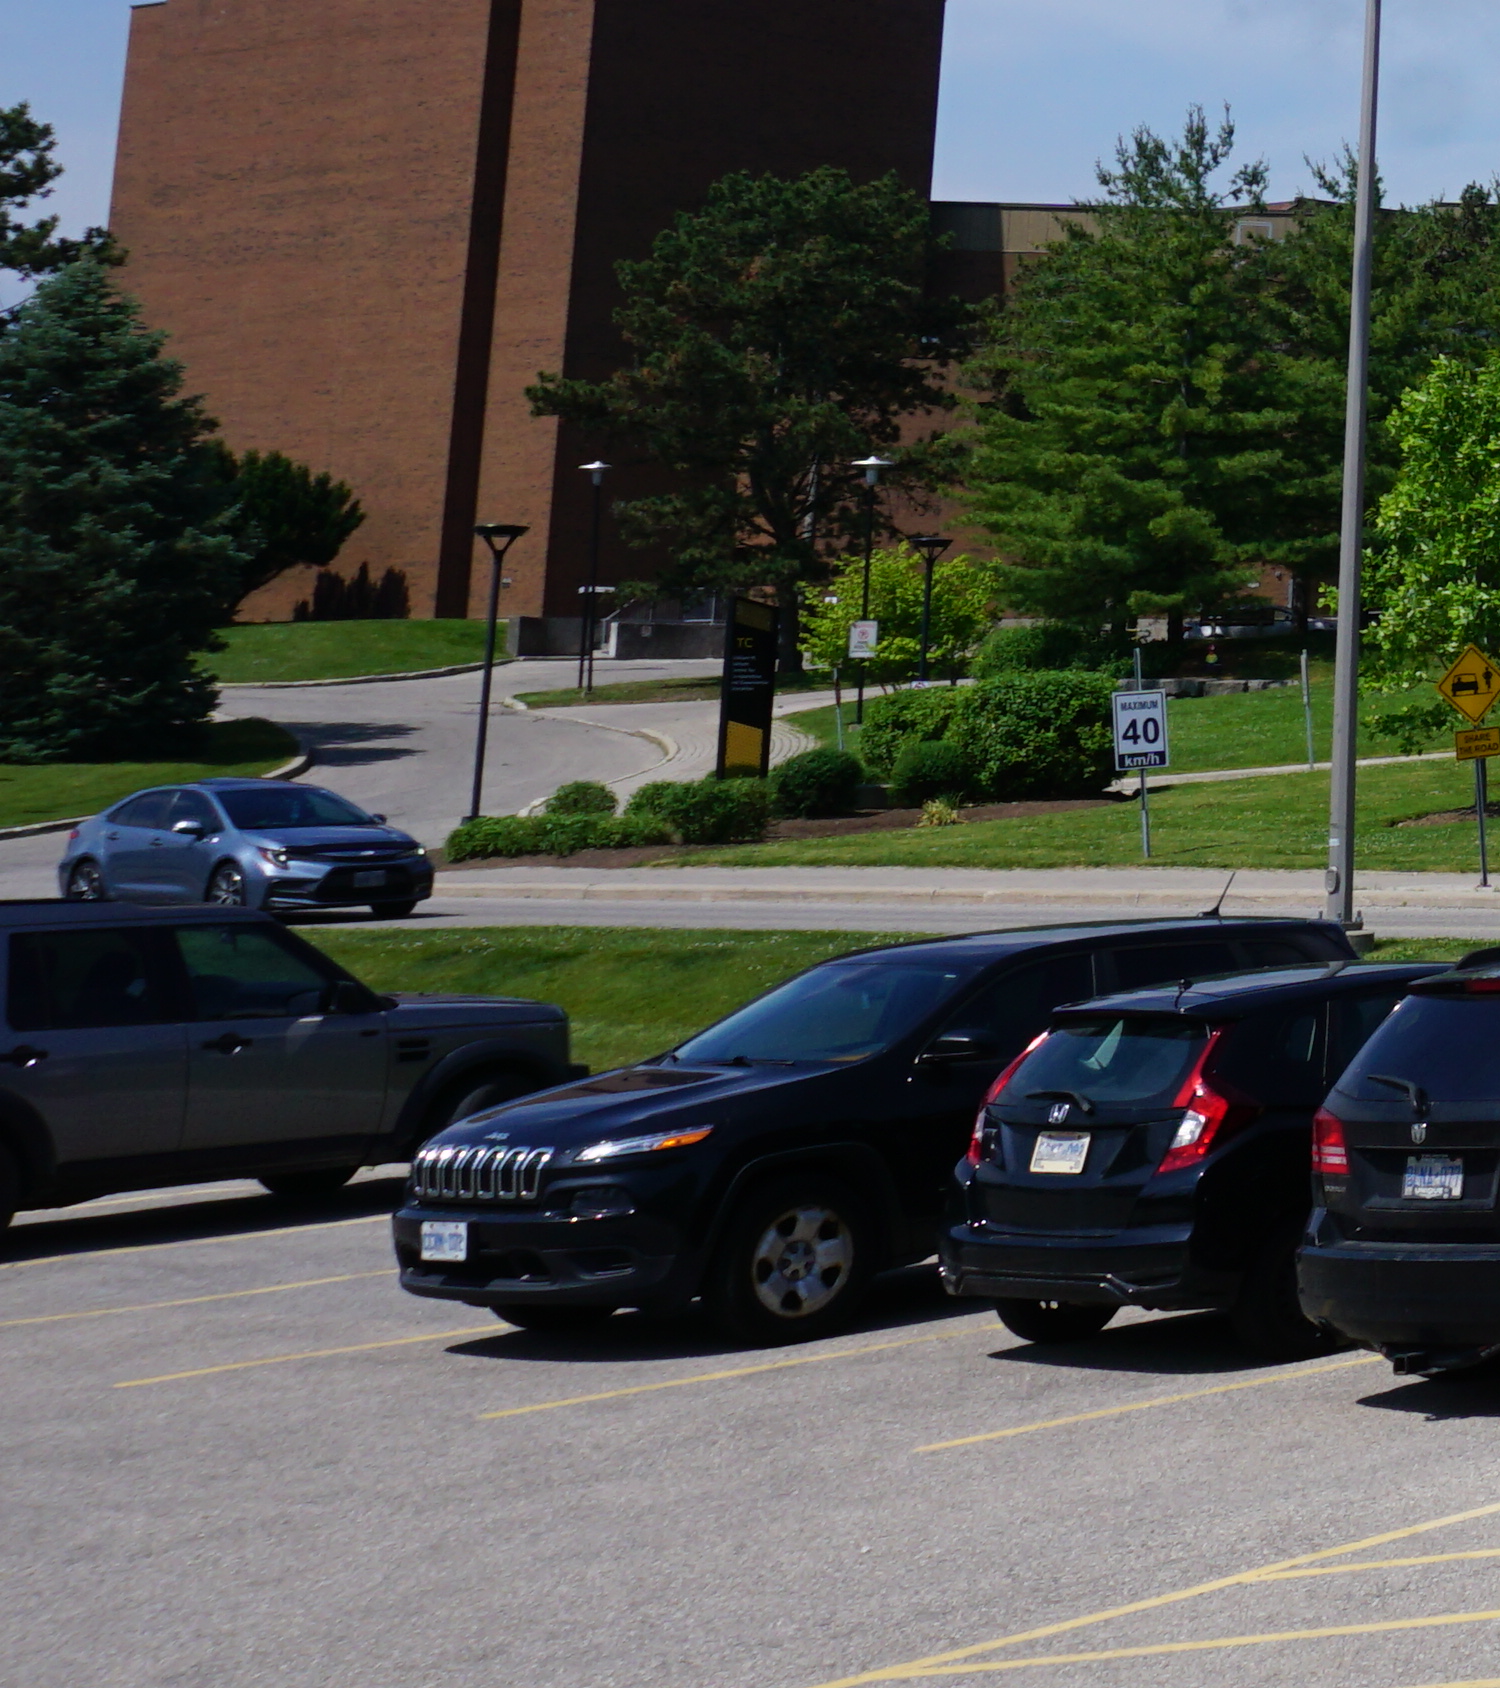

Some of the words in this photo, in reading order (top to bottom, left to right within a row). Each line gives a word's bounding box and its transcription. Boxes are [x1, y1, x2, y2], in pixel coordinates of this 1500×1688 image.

[737, 637, 754, 648] TC
[1121, 700, 1159, 711] MAXIMUM
[1122, 717, 1160, 745] 40
[1464, 732, 1491, 744] SHARE
[1459, 745, 1473, 755] THE
[1474, 742, 1499, 753] ROAD
[1124, 752, 1160, 767] km/h
